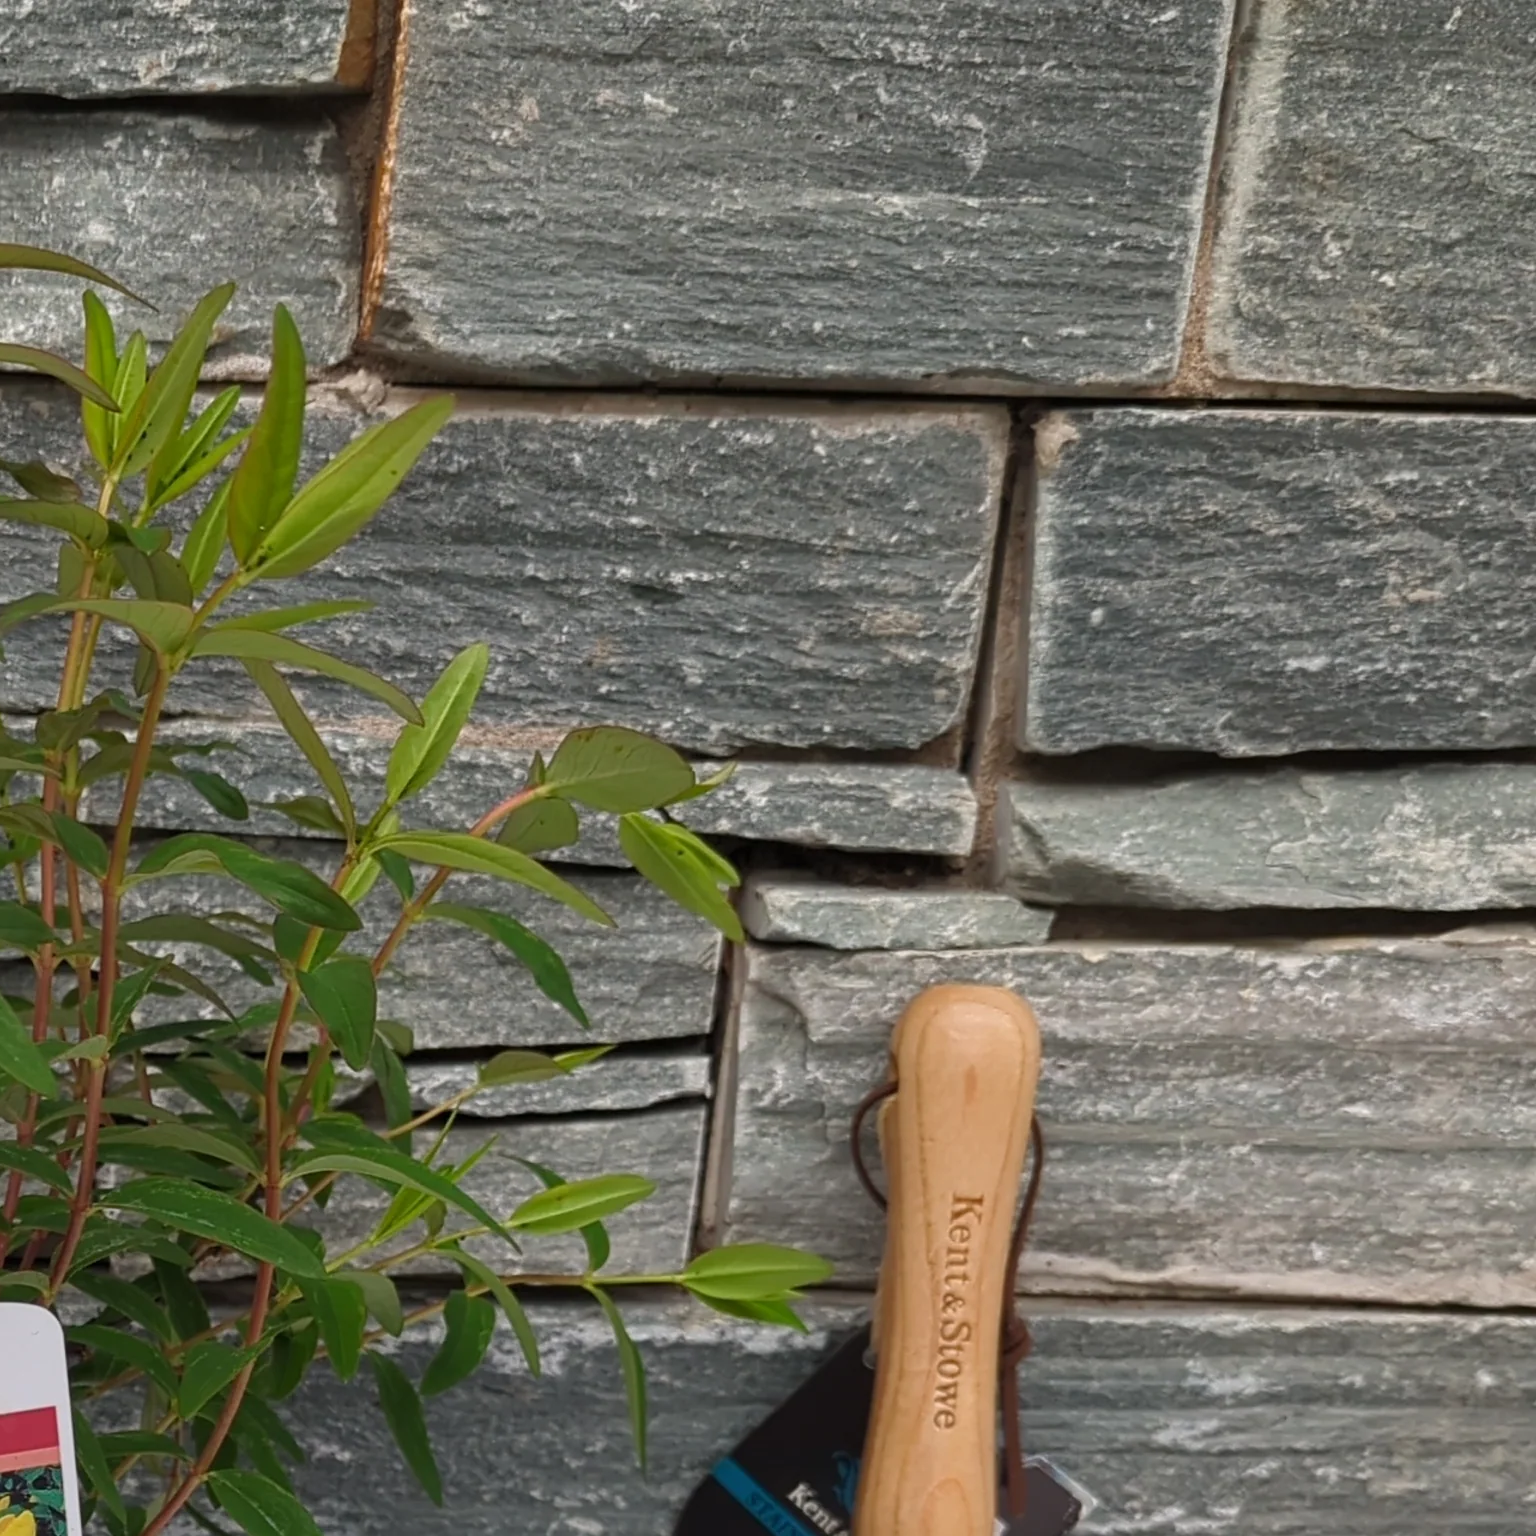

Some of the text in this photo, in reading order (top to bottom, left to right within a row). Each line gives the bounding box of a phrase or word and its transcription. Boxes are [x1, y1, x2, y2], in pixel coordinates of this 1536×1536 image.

[933, 1191, 985, 1431] Kent & Stowe
[785, 1480, 840, 1536] Kent
